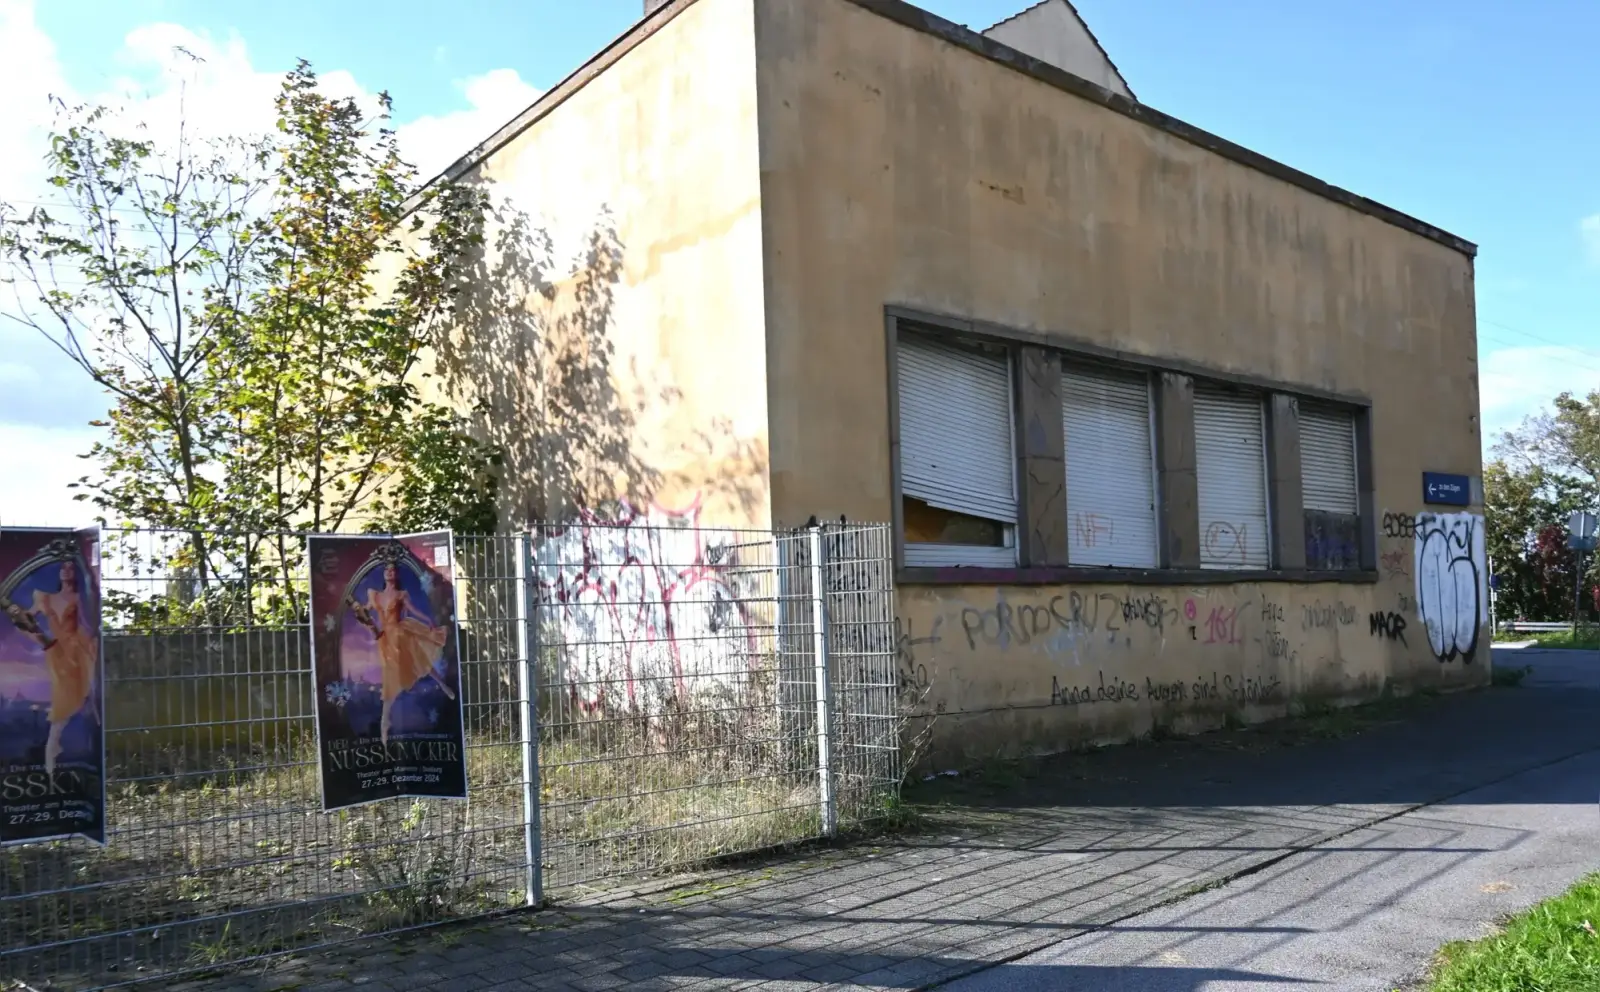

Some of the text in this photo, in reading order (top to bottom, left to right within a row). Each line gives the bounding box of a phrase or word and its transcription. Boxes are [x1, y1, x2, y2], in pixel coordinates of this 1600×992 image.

[1203, 605, 1242, 646] 161
[1051, 675, 1091, 705] Anna
[1097, 670, 1139, 702] deine
[1192, 671, 1219, 700] sind
[328, 740, 458, 772] NUSSKNACKER
[391, 774, 423, 783] Dezember
[424, 773, 440, 783] 2024
